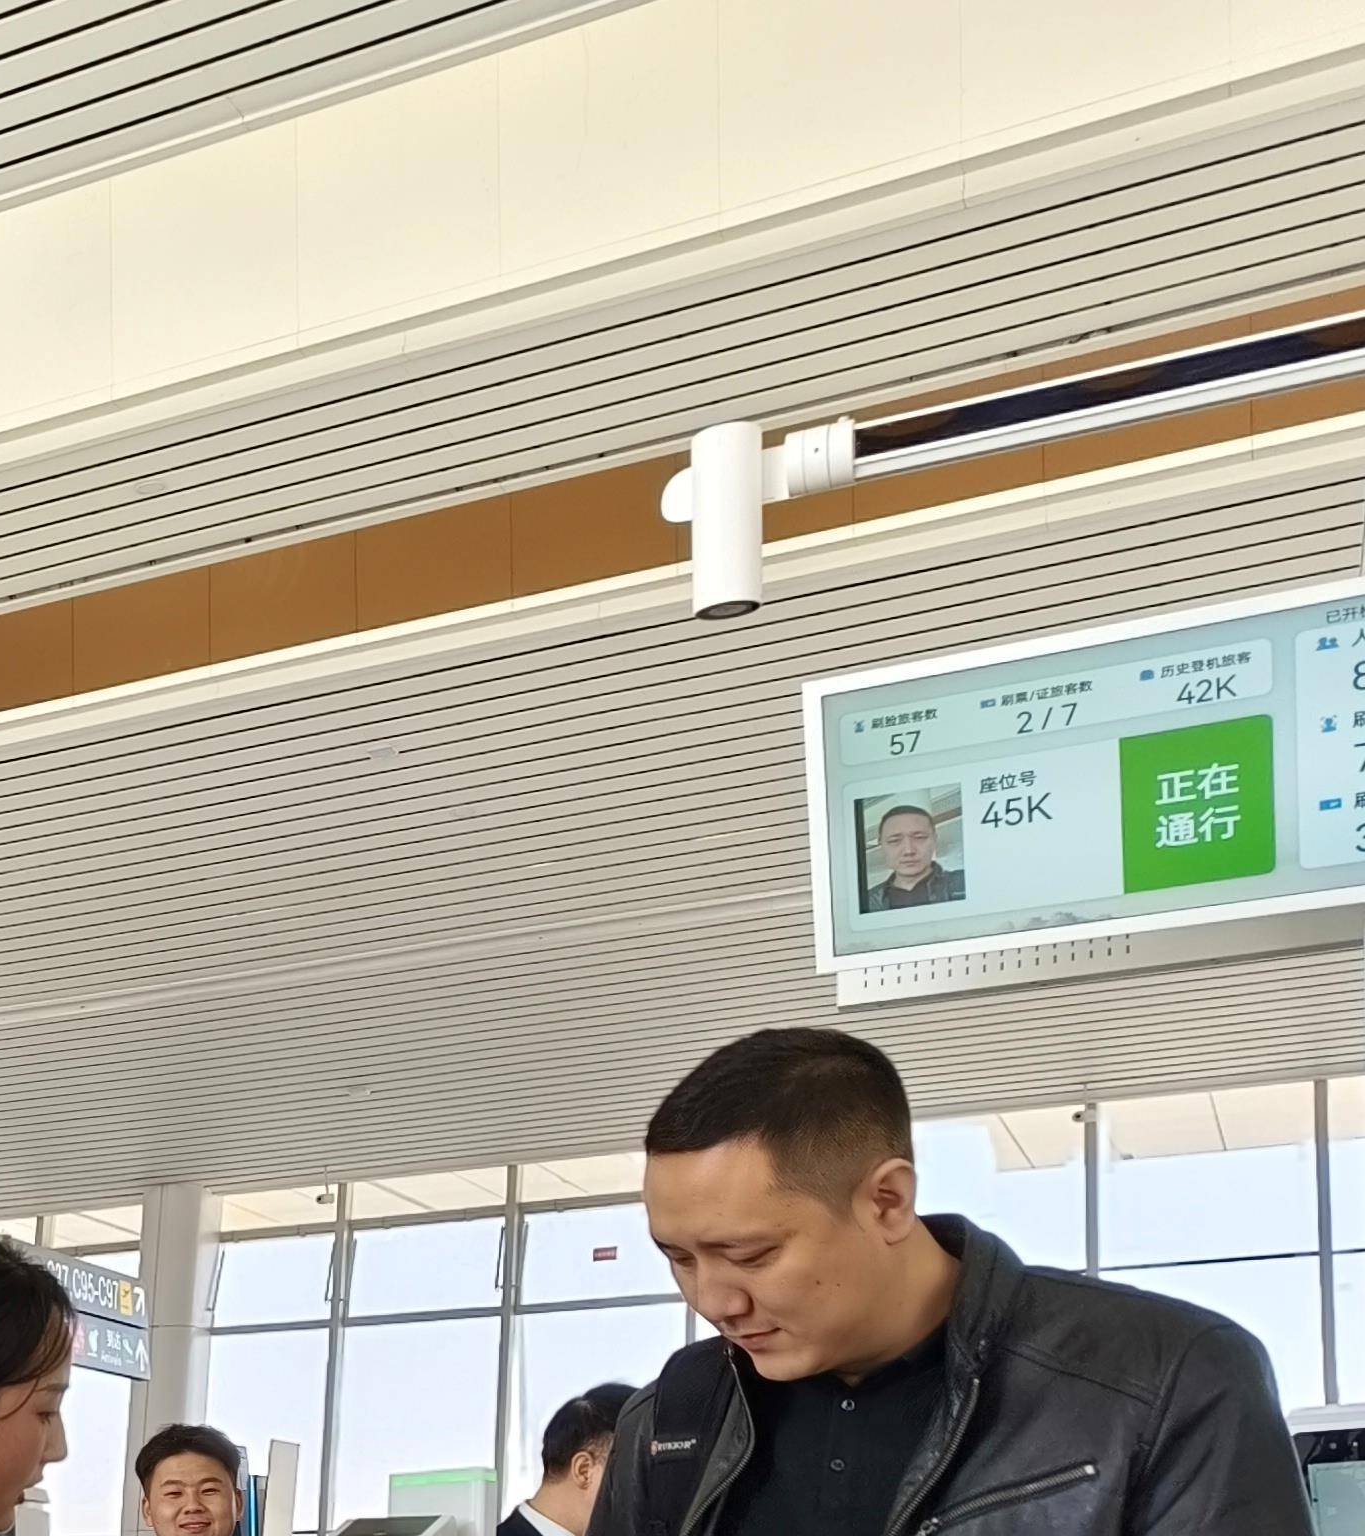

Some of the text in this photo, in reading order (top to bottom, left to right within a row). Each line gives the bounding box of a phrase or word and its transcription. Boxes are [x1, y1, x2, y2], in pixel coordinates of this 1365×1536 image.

[1160, 651, 1252, 678] 历史登机旅客
[1176, 674, 1238, 704] 42K
[871, 708, 938, 730] 刷脸旅客数
[889, 730, 922, 756] 57
[979, 771, 1037, 794] 座位号
[1155, 762, 1240, 806] 正在
[980, 792, 1054, 828] 45K
[1155, 804, 1241, 849] 通行
